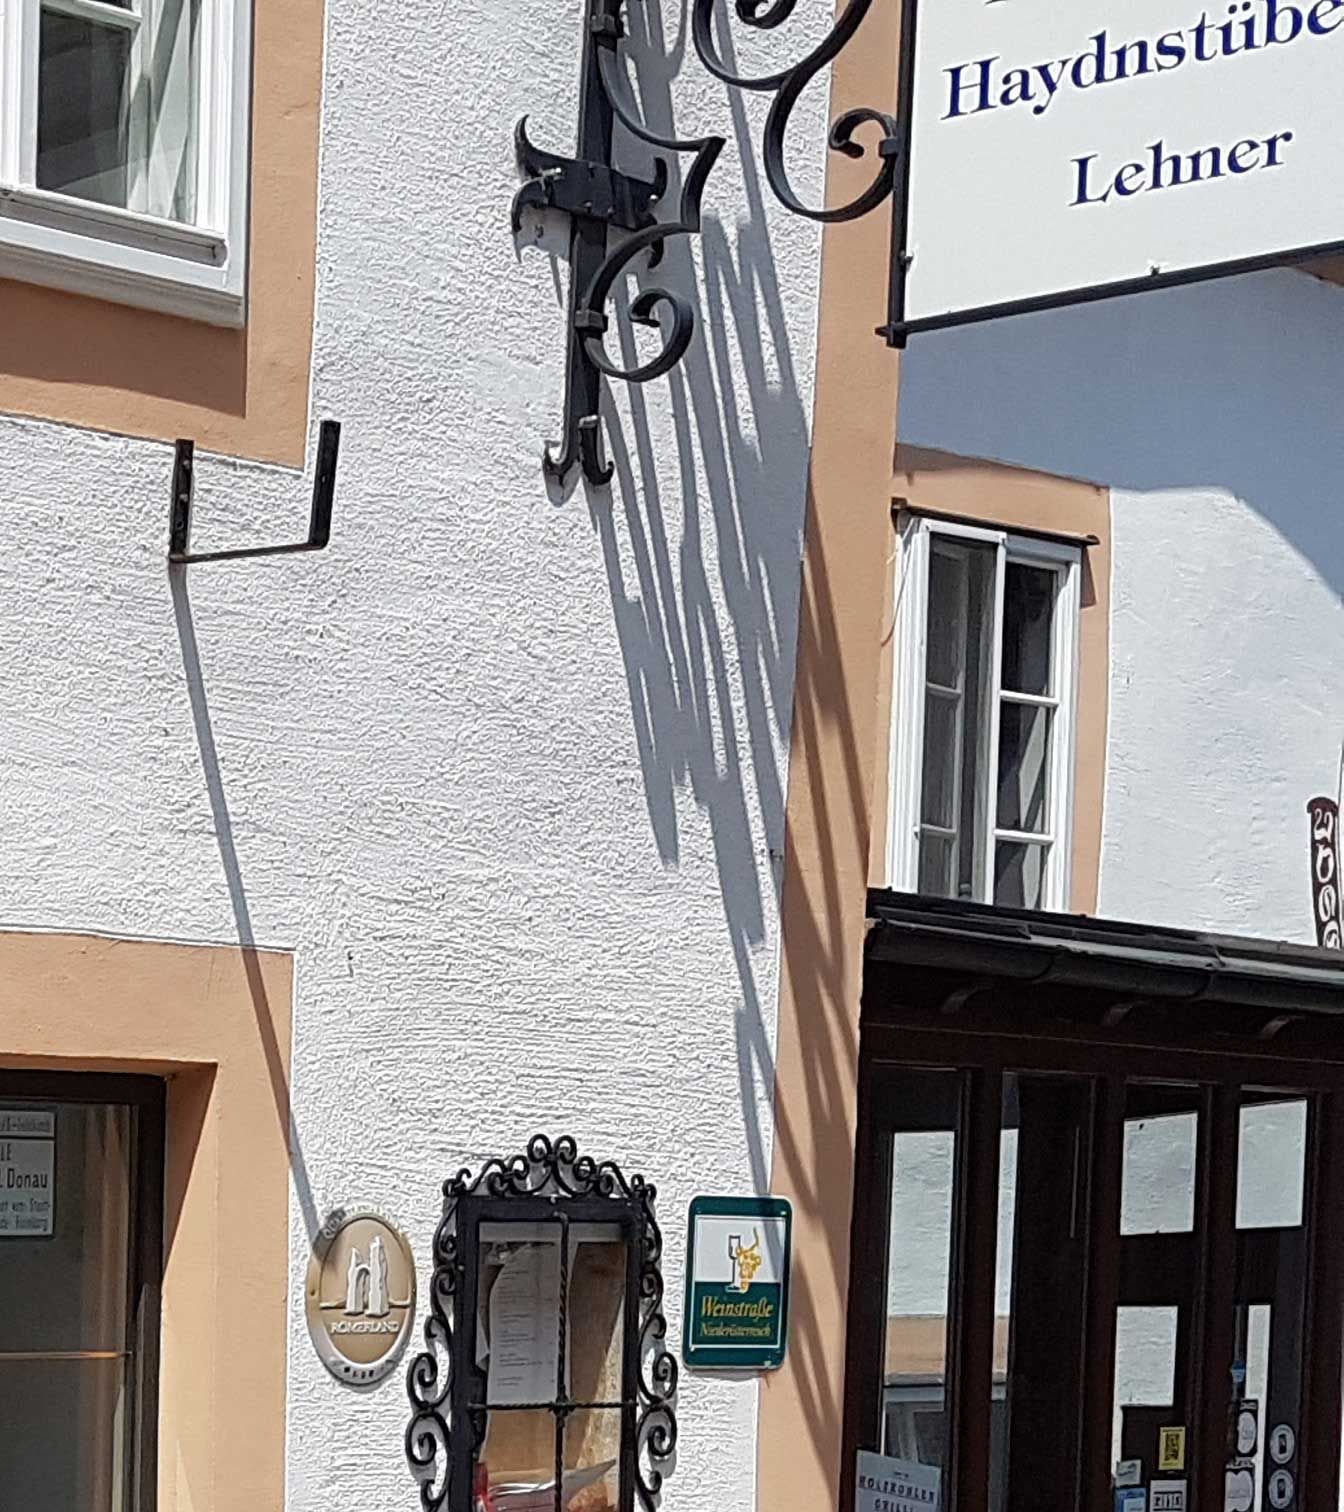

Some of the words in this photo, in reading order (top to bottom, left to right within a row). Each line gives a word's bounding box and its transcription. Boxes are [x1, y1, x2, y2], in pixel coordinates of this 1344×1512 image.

[1068, 131, 1294, 206] Lehner
[7, 1167, 48, 1189] Donau
[702, 1296, 773, 1322] Weinstraße
